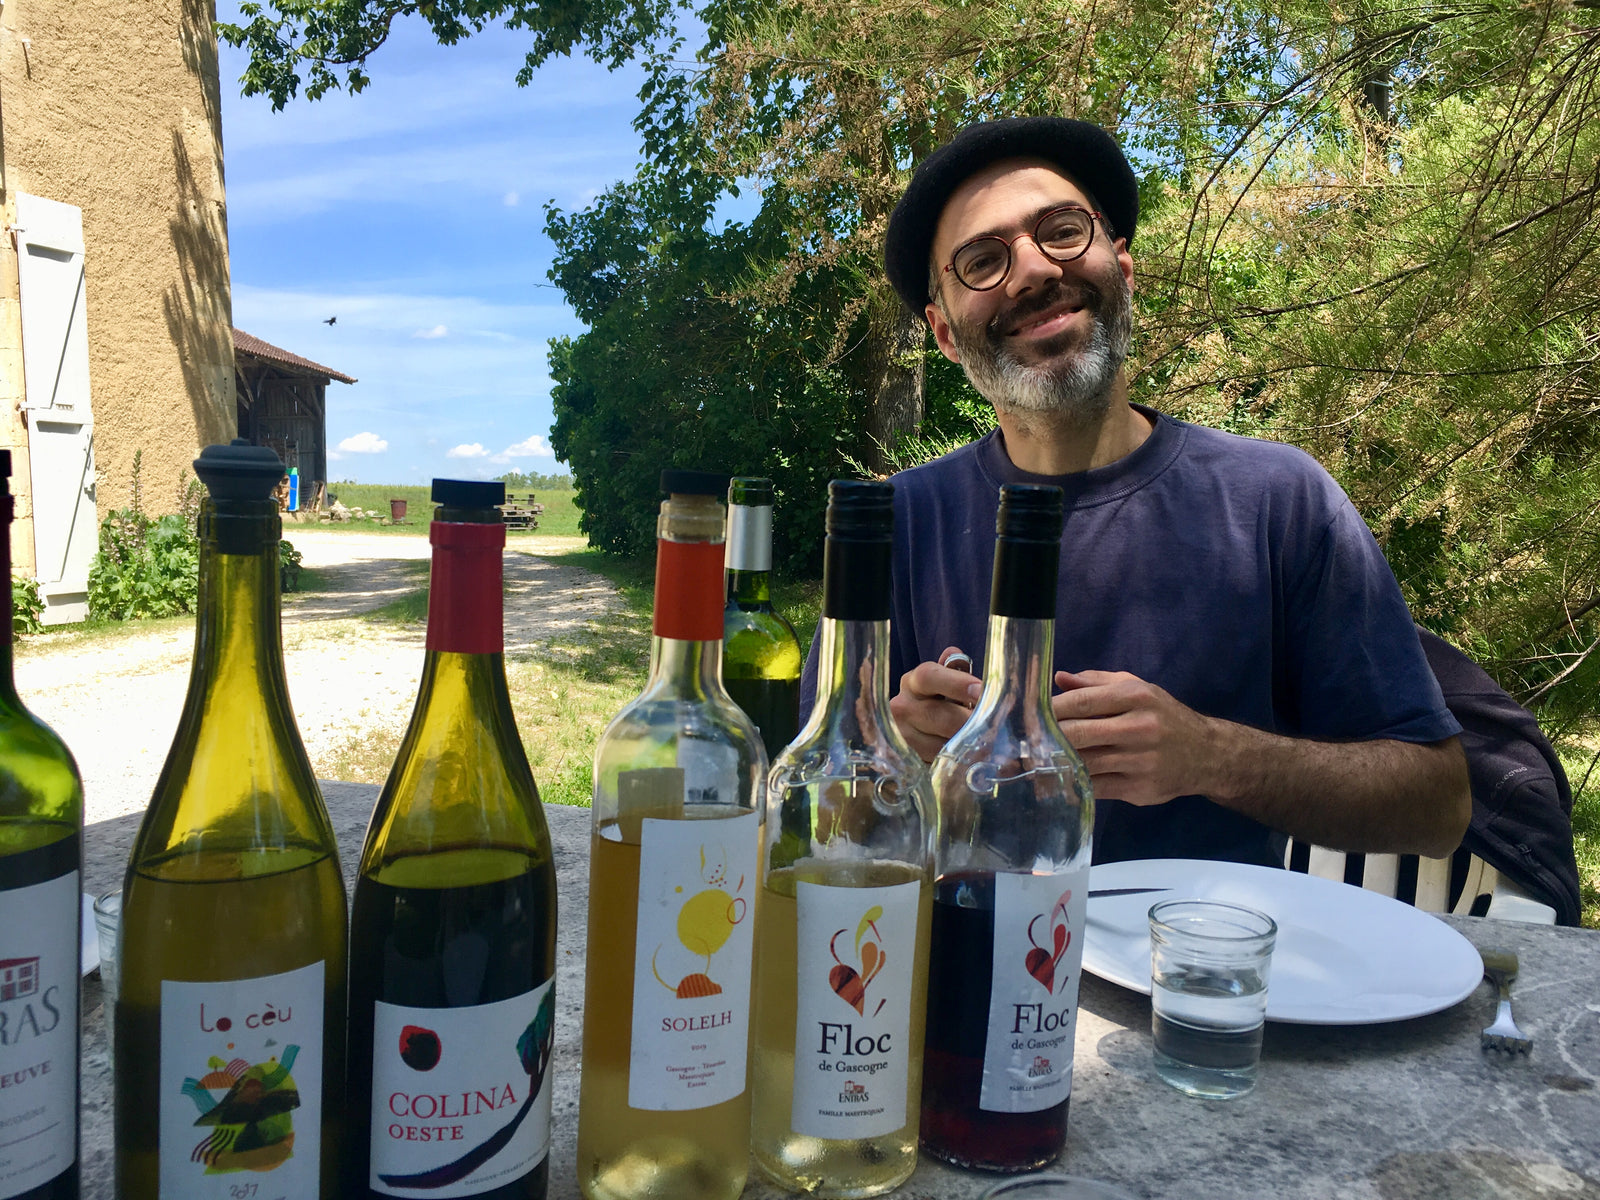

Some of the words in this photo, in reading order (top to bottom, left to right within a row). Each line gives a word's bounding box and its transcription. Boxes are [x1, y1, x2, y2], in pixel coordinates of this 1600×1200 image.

[661, 1010, 732, 1032] SOLELH
[1010, 1002, 1070, 1034] Floc
[817, 1021, 892, 1056] Floc
[1011, 1039, 1024, 1050] de
[819, 1060, 832, 1071] de
[835, 1061, 888, 1075] Gascogne
[389, 1083, 517, 1119] COLINA
[839, 1092, 869, 1103] ENTRAS
[388, 1124, 464, 1142] OESTE
